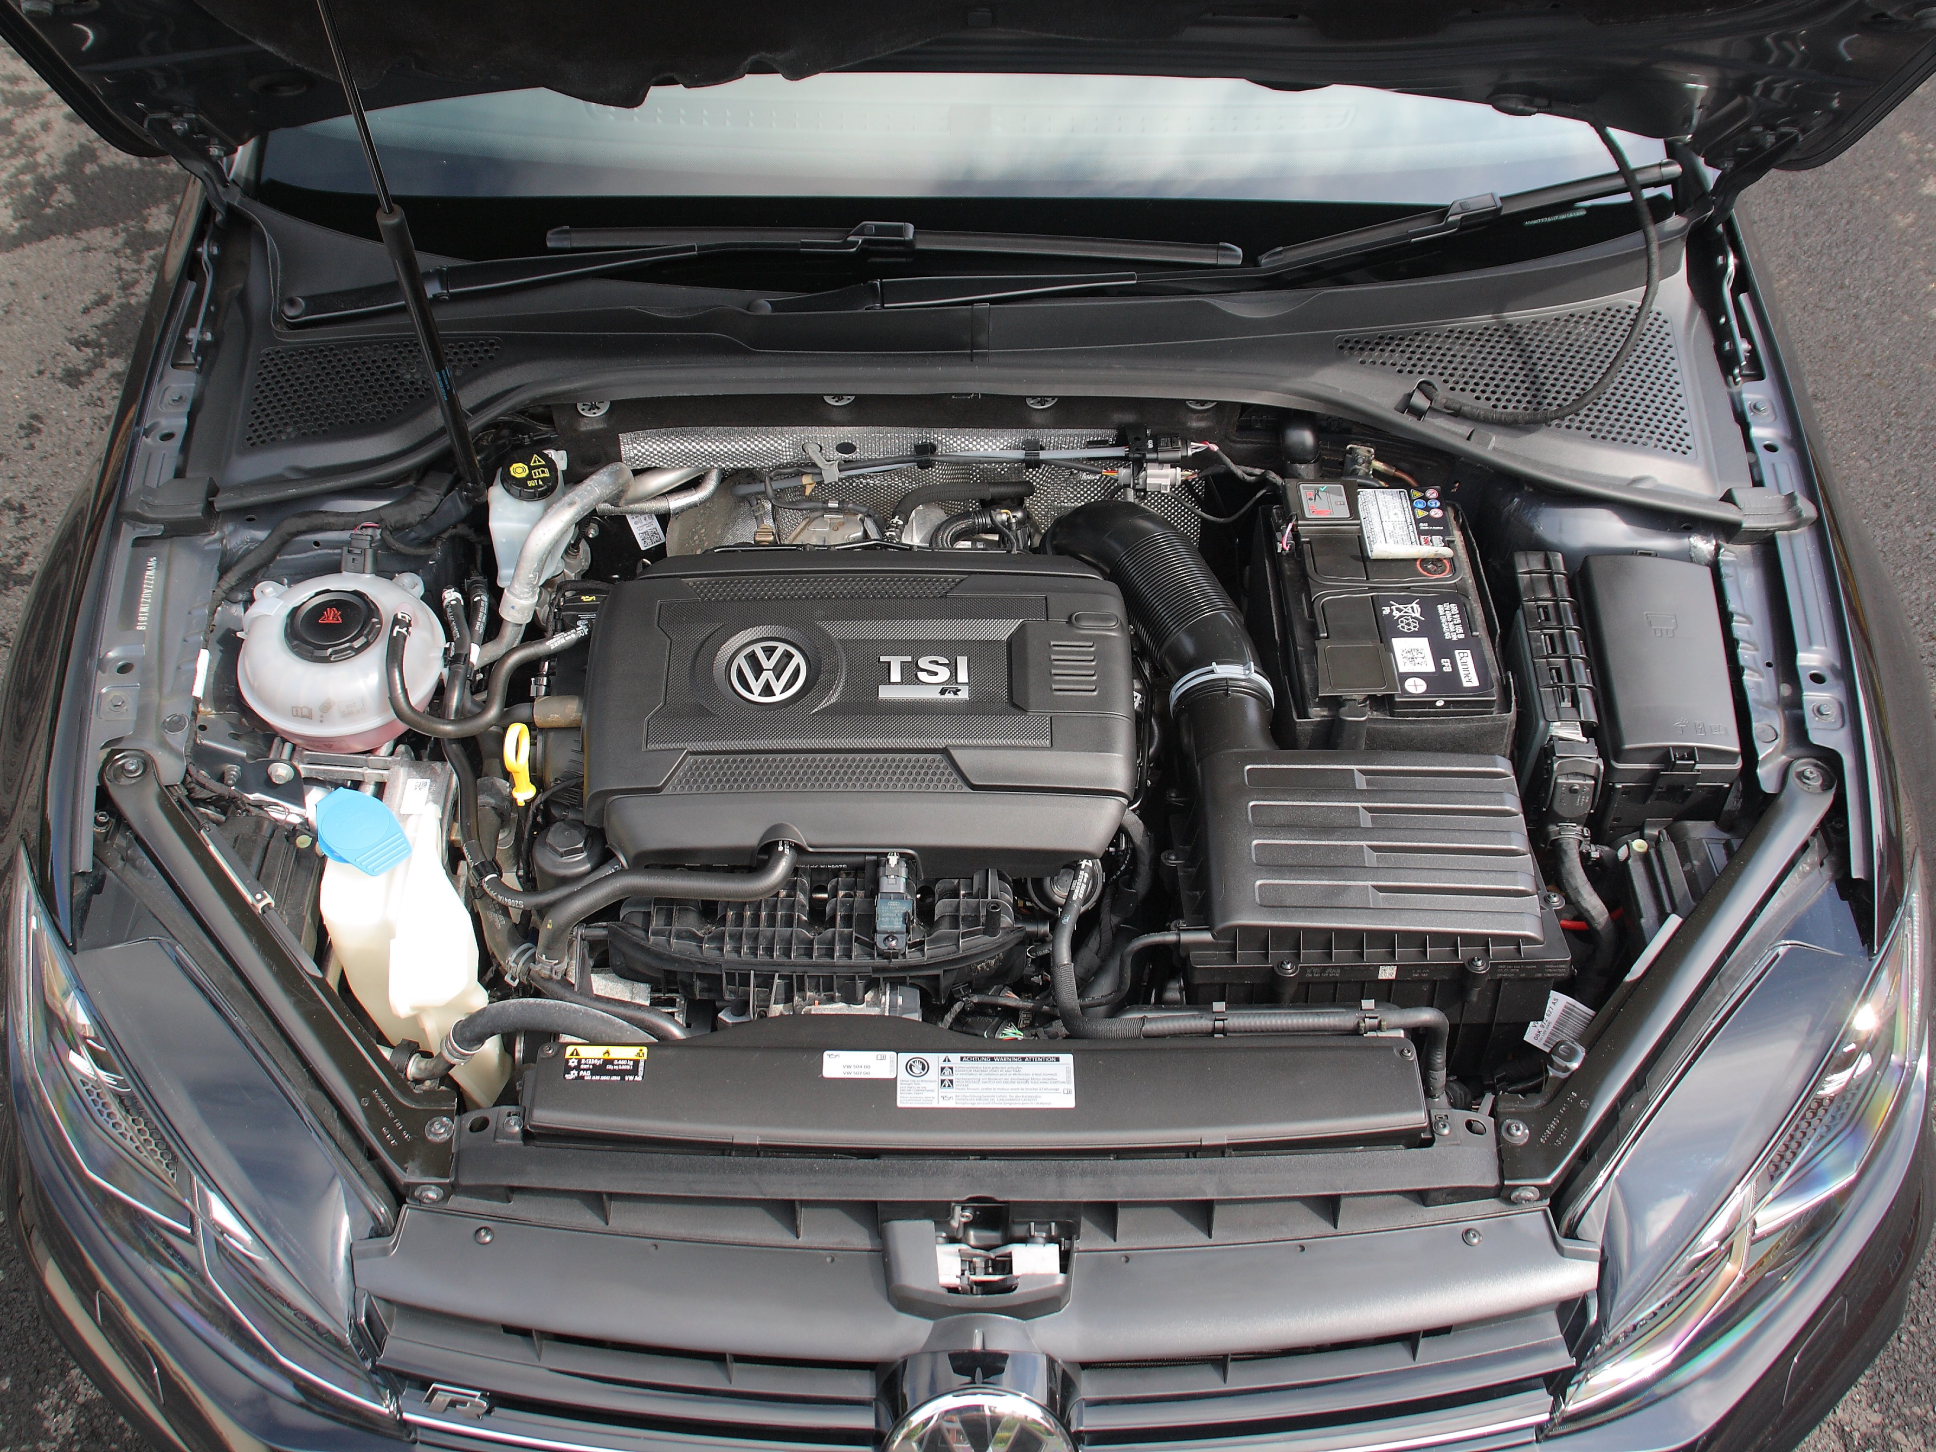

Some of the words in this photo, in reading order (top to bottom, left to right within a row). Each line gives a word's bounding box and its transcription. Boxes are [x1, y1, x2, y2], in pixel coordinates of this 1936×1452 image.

[878, 655, 970, 684] TSI
[1441, 658, 1453, 673] EFB
[1458, 651, 1473, 683] Banner
[938, 686, 962, 697] R
[422, 1383, 487, 1420] R
